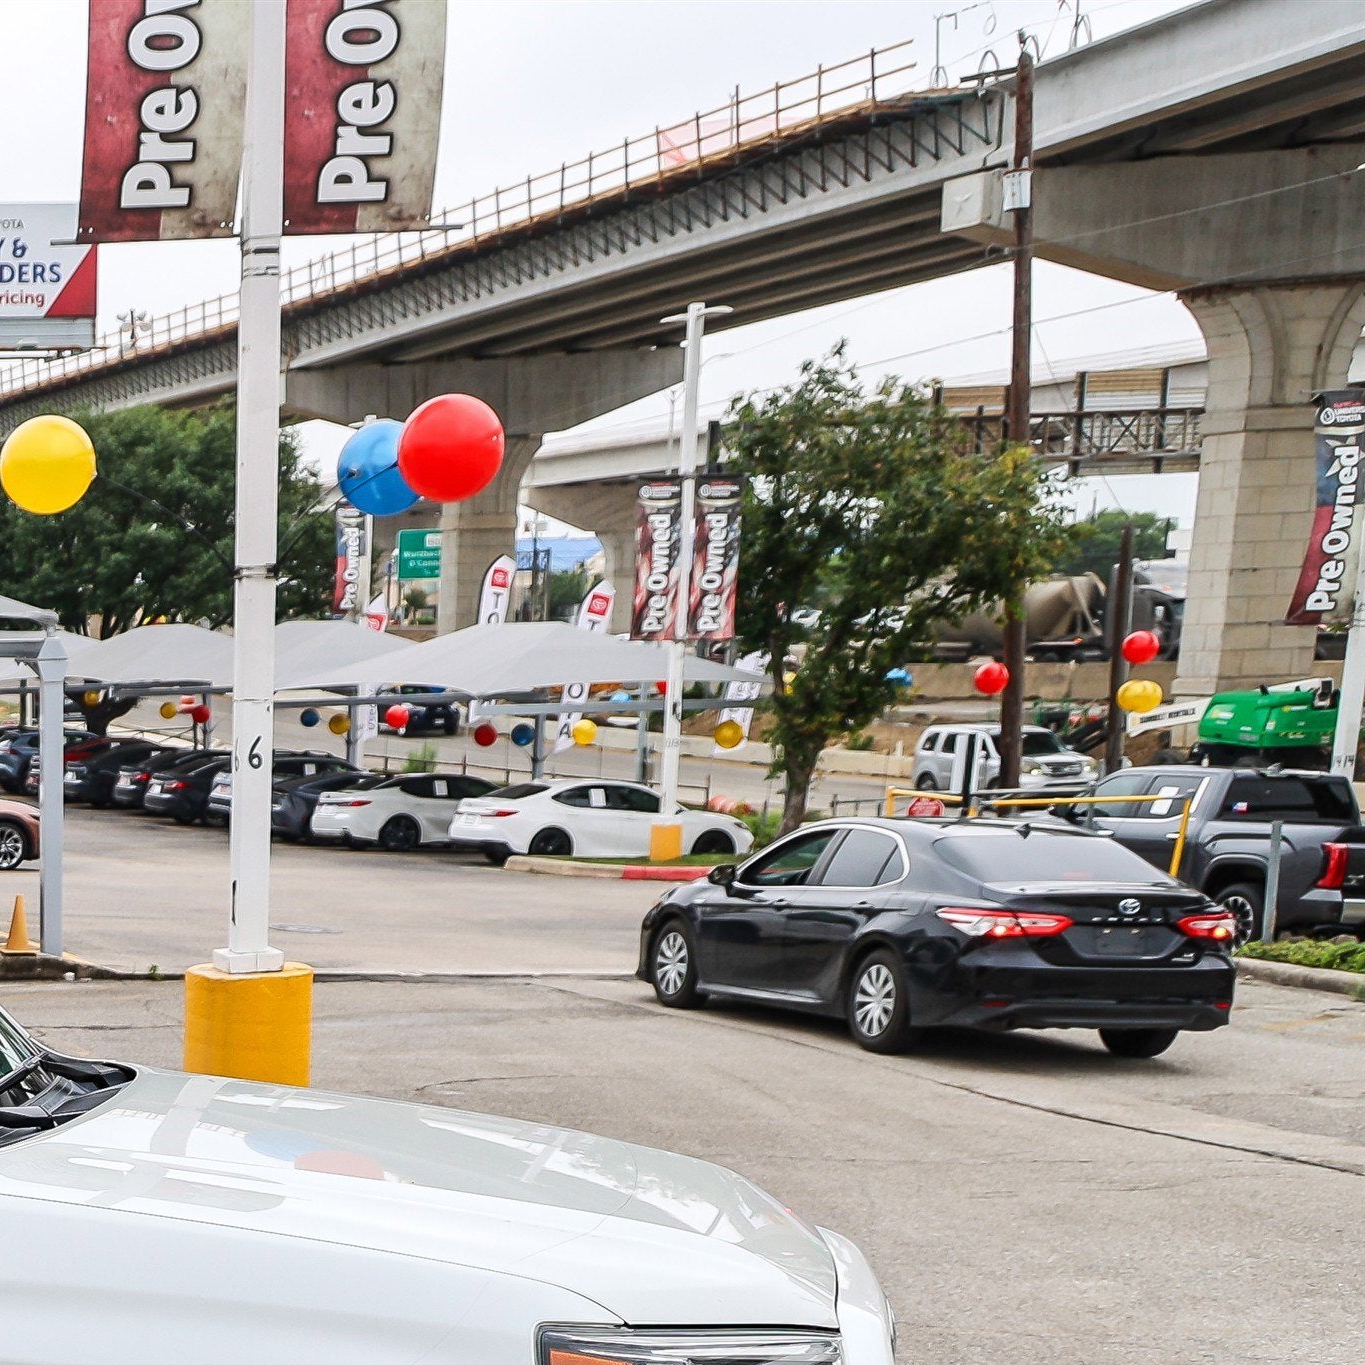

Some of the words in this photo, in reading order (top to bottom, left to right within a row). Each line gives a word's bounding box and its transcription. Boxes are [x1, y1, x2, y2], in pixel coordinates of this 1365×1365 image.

[128, 0, 203, 72] O
[325, 0, 400, 66] O
[121, 88, 200, 210] Pre
[317, 81, 397, 204] Pre
[12, 236, 29, 259] &
[1322, 445, 1361, 554] Owned
[343, 526, 361, 582] Owned
[645, 512, 672, 592] Owned
[699, 512, 729, 591] Owned
[640, 593, 667, 633] Pre
[696, 593, 722, 633] Pre
[1306, 559, 1345, 613] Pre
[249, 735, 263, 769] 6
